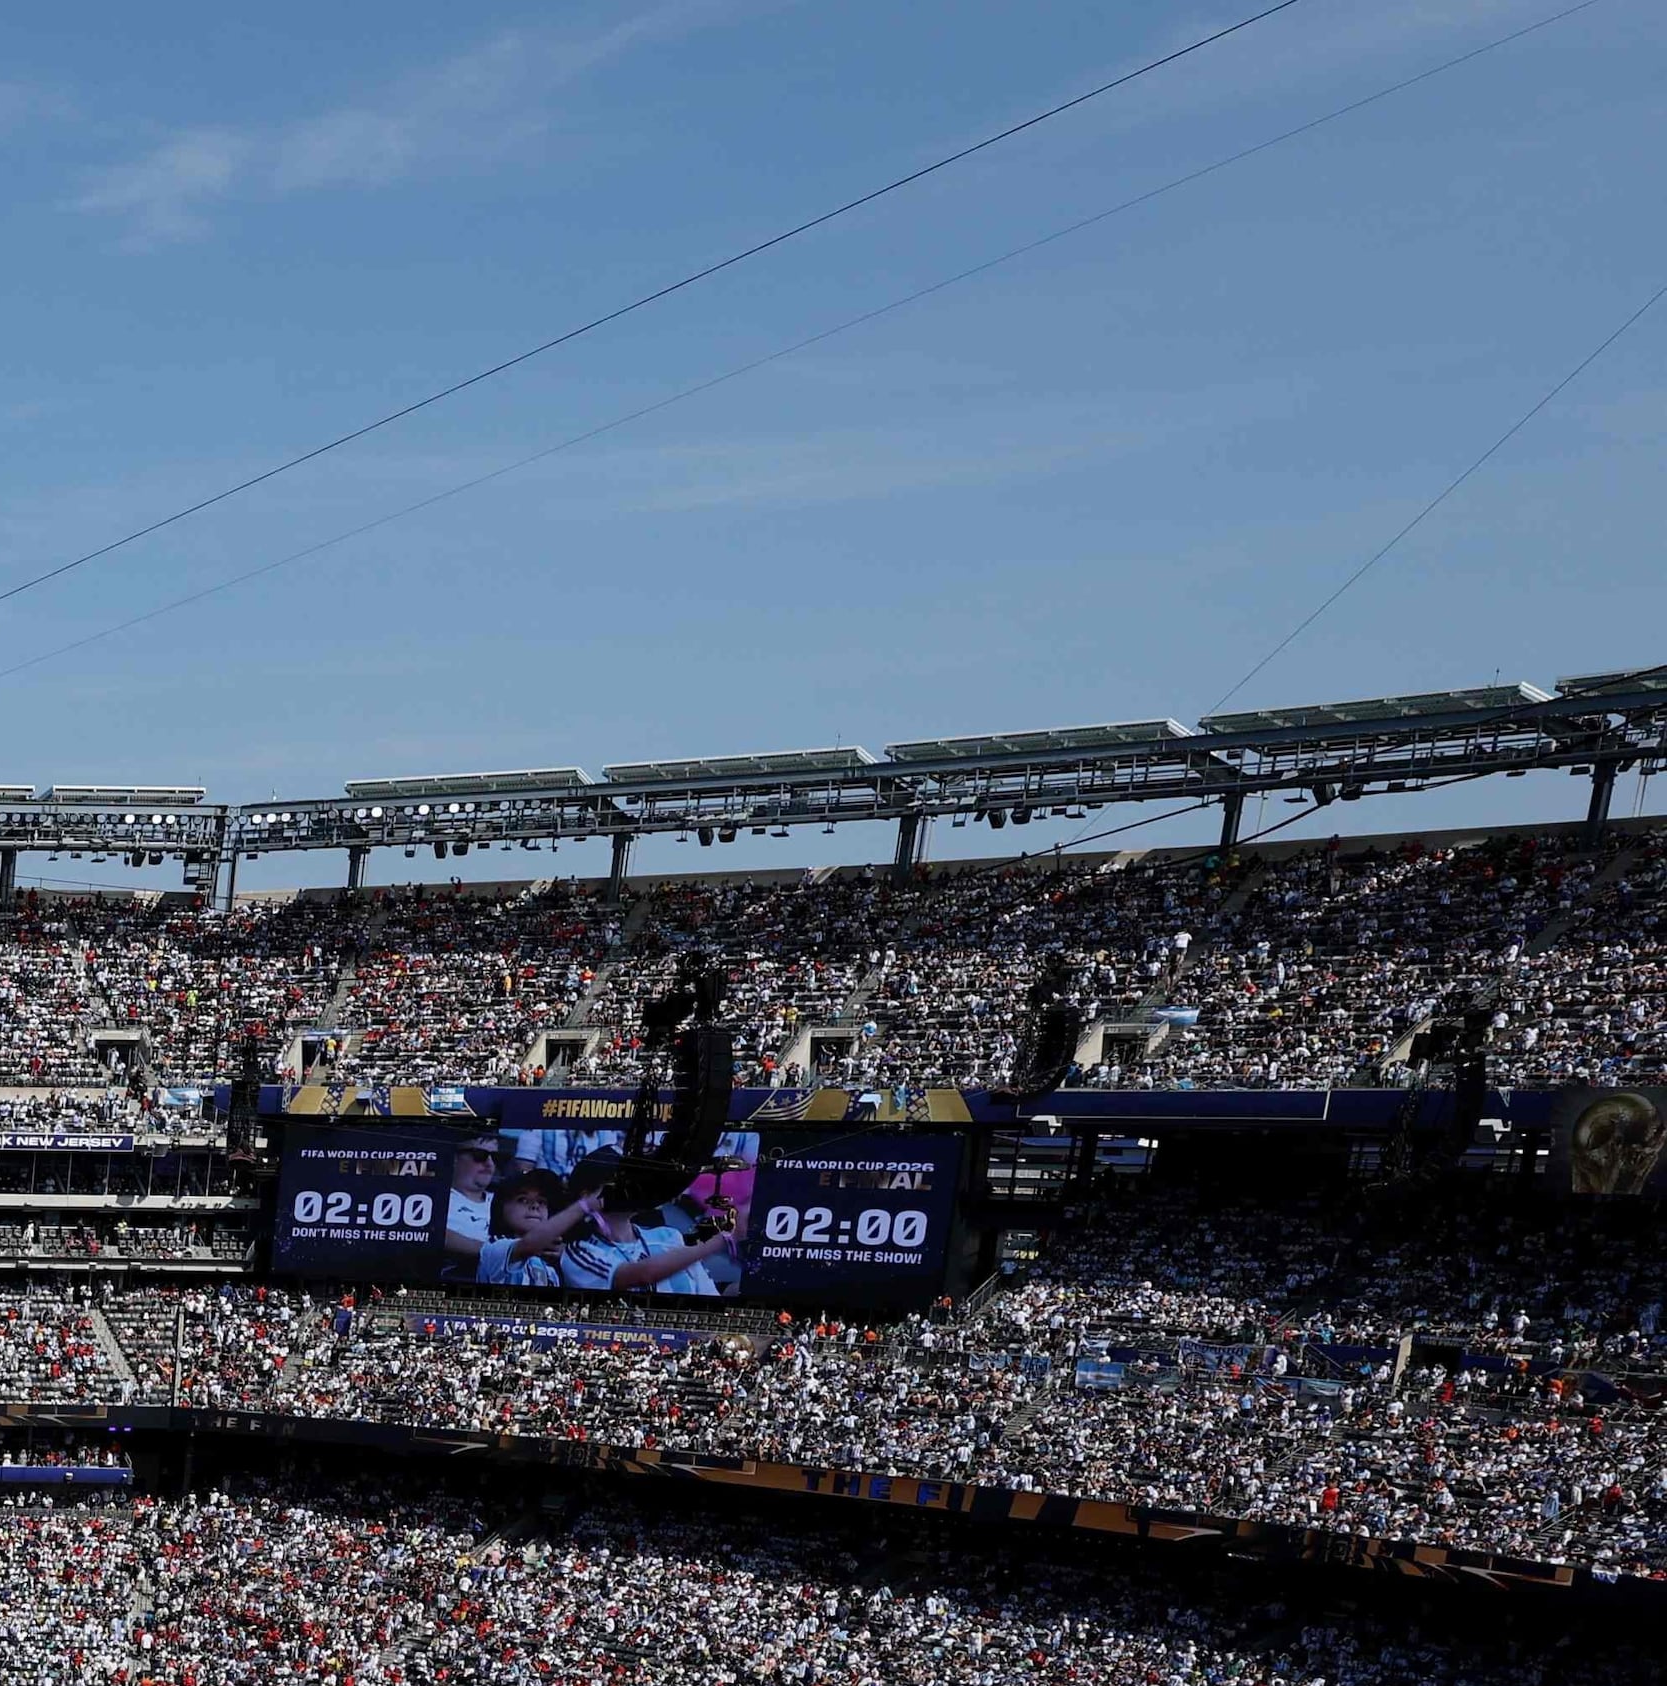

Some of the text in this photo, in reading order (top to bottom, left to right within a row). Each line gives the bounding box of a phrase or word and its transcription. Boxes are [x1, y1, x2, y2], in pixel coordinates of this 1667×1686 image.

[16, 1135, 53, 1148] NEW
[57, 1136, 123, 1148] JERSEY
[301, 1149, 437, 1161] FIFA WORLD CUP 2026
[776, 1159, 934, 1172] FIFA WORLD CUP 2026
[293, 1190, 433, 1227] 02:00
[292, 1226, 429, 1243] DON'T MISS THE SHOW!
[765, 1205, 928, 1247] 02:00
[762, 1246, 922, 1265] DON'T MISS THE SHOW!
[537, 1326, 656, 1343] 2026 THE FINAL
[801, 1469, 892, 1500] THE
